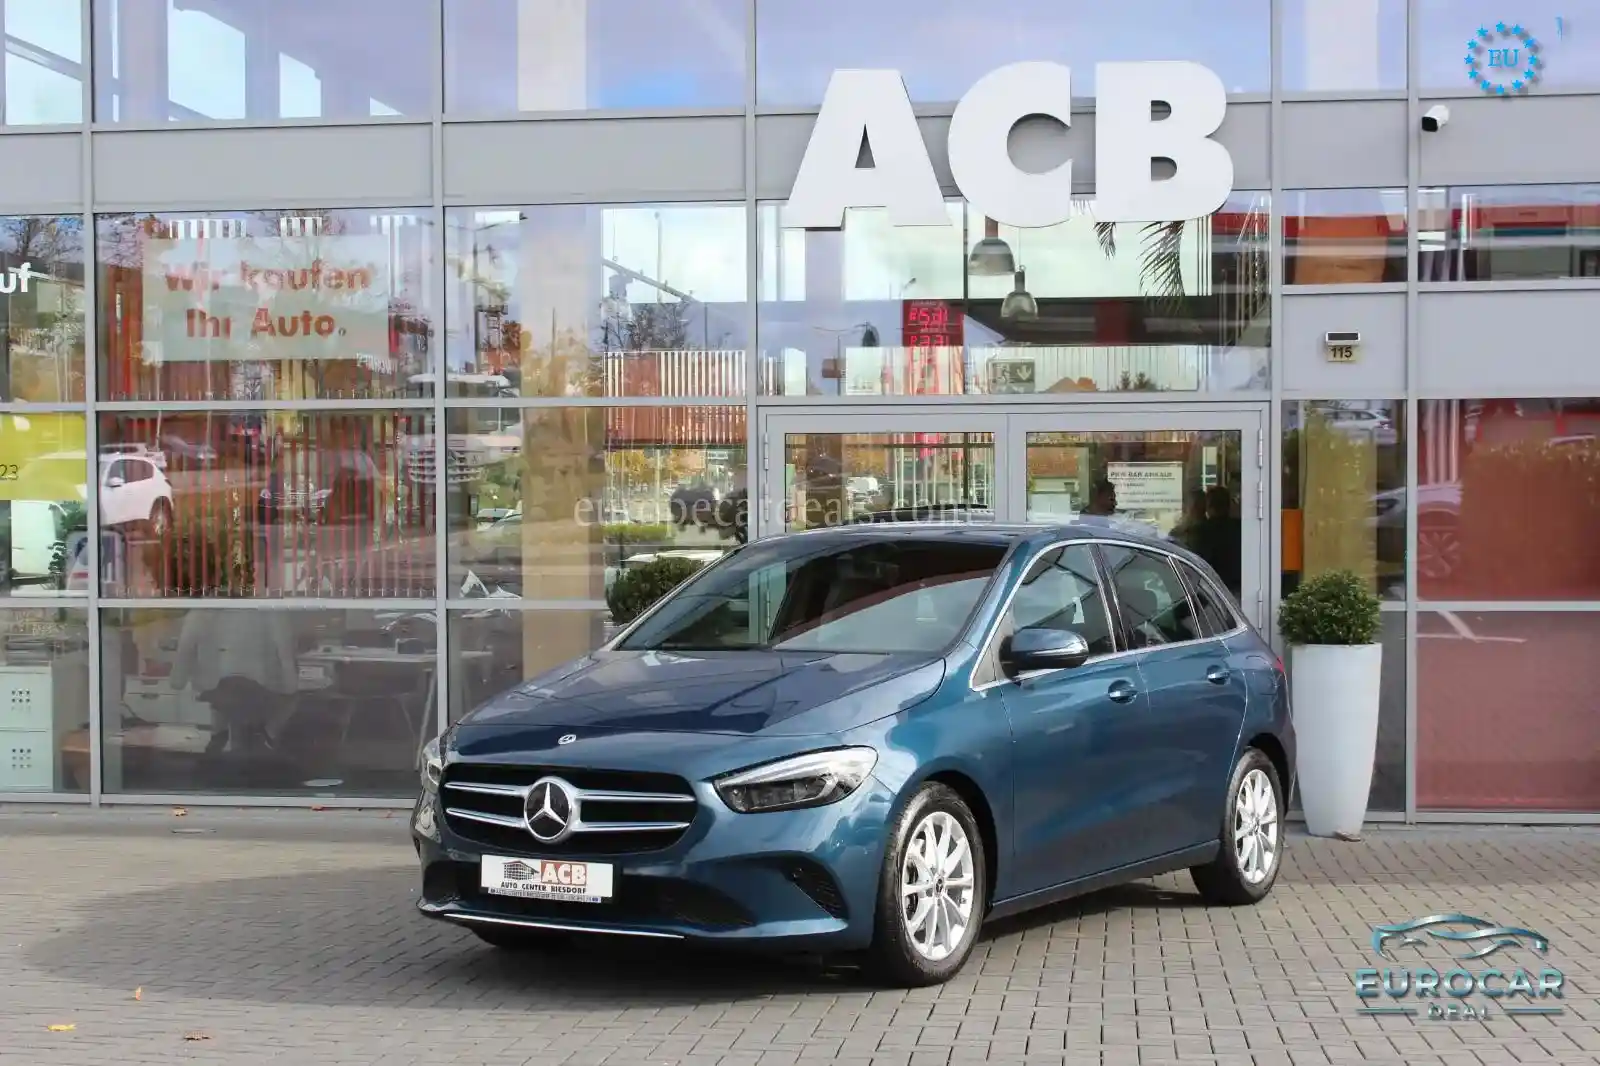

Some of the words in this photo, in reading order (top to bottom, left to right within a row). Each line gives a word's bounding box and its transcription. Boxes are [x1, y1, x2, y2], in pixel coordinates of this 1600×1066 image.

[779, 60, 1234, 229] ACB
[186, 307, 235, 338] Ihr
[1331, 346, 1353, 359] 115
[541, 863, 587, 885] ACB
[500, 881, 518, 890] AUTO
[521, 883, 547, 892] CENTER
